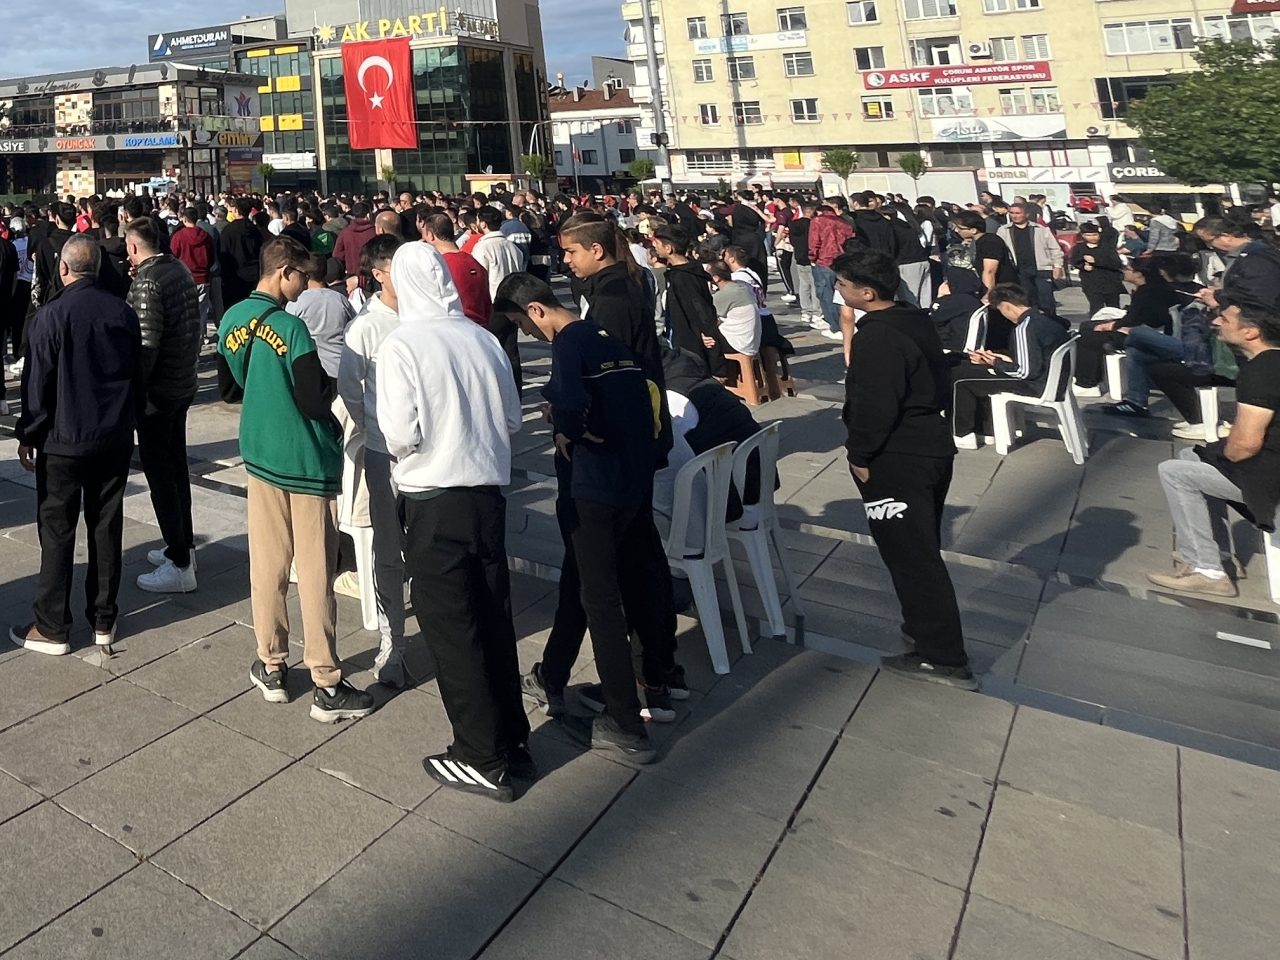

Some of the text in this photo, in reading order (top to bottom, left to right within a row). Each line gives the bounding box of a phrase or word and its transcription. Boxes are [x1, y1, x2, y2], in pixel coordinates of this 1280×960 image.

[341, 6, 448, 43] AK PARTİ
[942, 68, 973, 76] ÇORUM
[974, 66, 1010, 74] AMATÖR
[889, 72, 930, 84] ASKF
[934, 73, 1046, 84] KULÜPLERİ FEDERASYONU
[55, 137, 96, 150] OYUNCAK
[989, 171, 1027, 179] DAMLA
